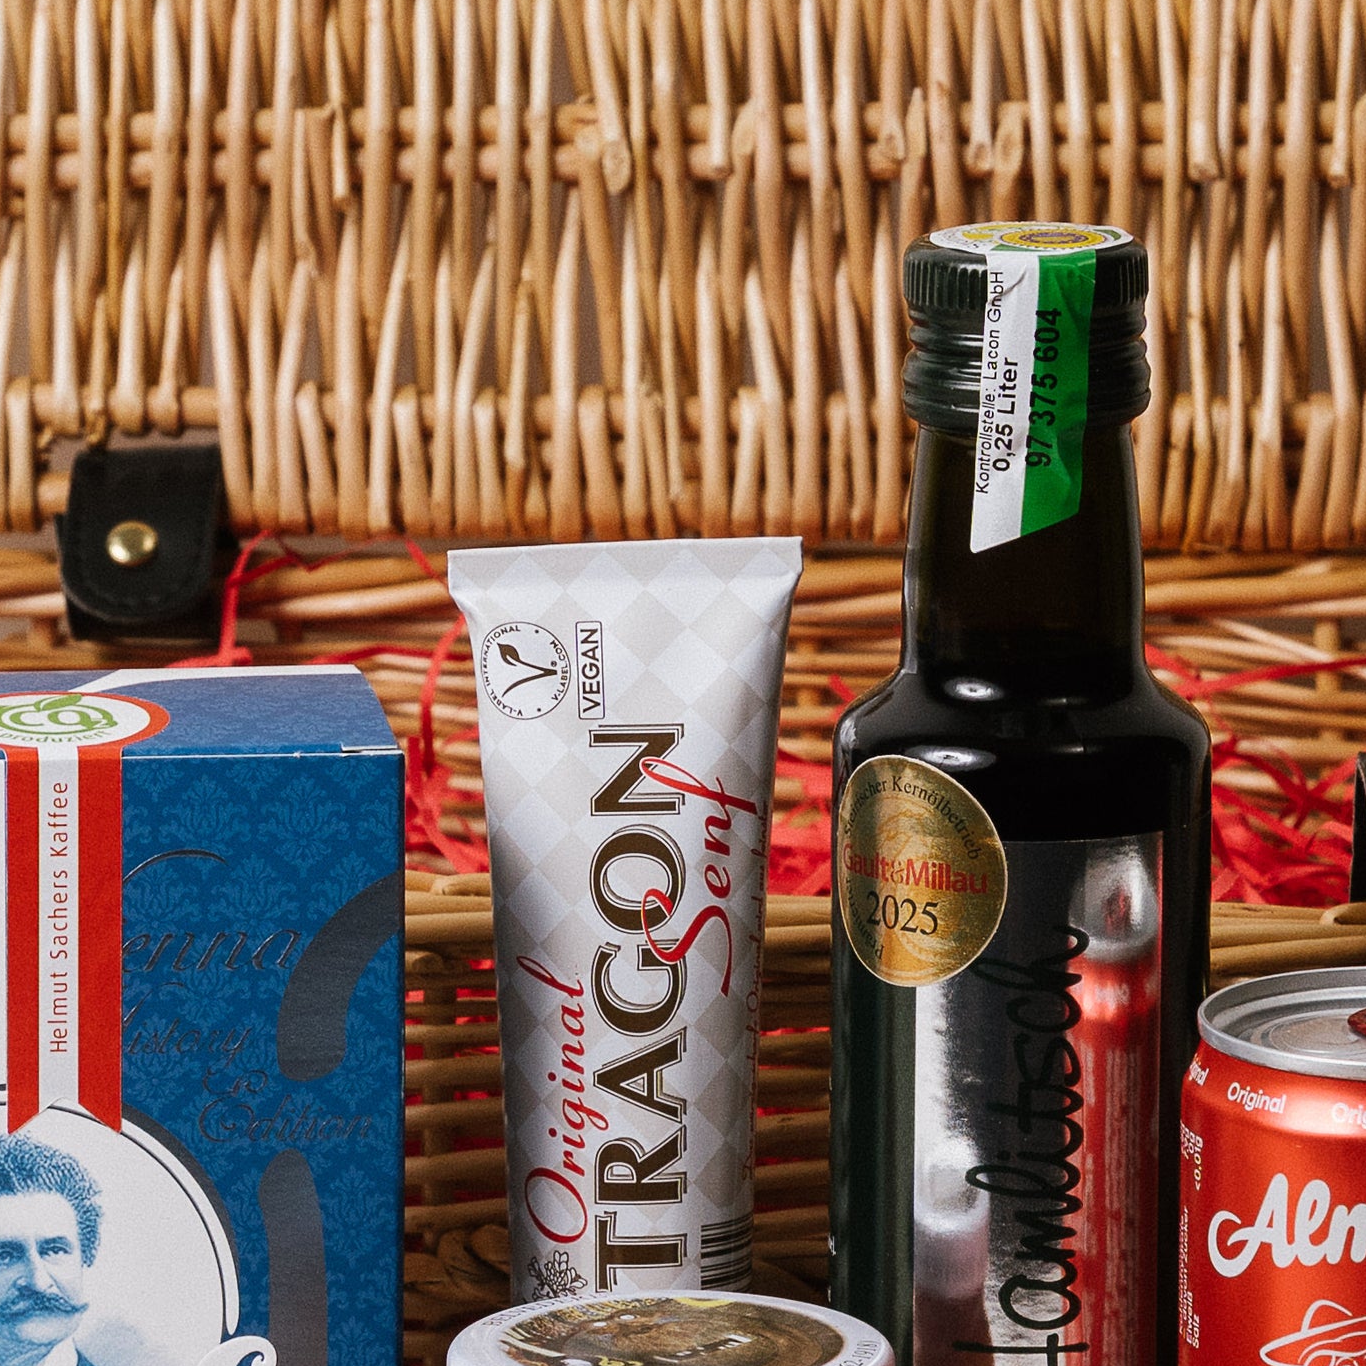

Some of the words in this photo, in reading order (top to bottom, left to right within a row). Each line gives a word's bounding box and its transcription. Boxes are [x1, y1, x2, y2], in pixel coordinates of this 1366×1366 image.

[987, 270, 1005, 324] GmbH
[983, 326, 1001, 382] Lacon
[1033, 307, 1062, 364] 604
[997, 356, 1019, 417] Liter
[1028, 372, 1058, 428] 375
[975, 387, 996, 494] Kontrollstelle:
[992, 423, 1016, 473] 0,25
[1025, 431, 1053, 468] 97
[579, 628, 601, 714] VEGAN
[48, 782, 69, 858] Kaffee
[892, 775, 982, 861] Kernölbetrieb
[640, 756, 759, 998] Senf
[843, 843, 988, 894] Gault&Millau
[48, 869, 69, 960] Sachers
[866, 890, 939, 935] 2025
[48, 971, 69, 1053] Helmut
[516, 954, 609, 1244] Original
[1227, 1082, 1286, 1114] Original
